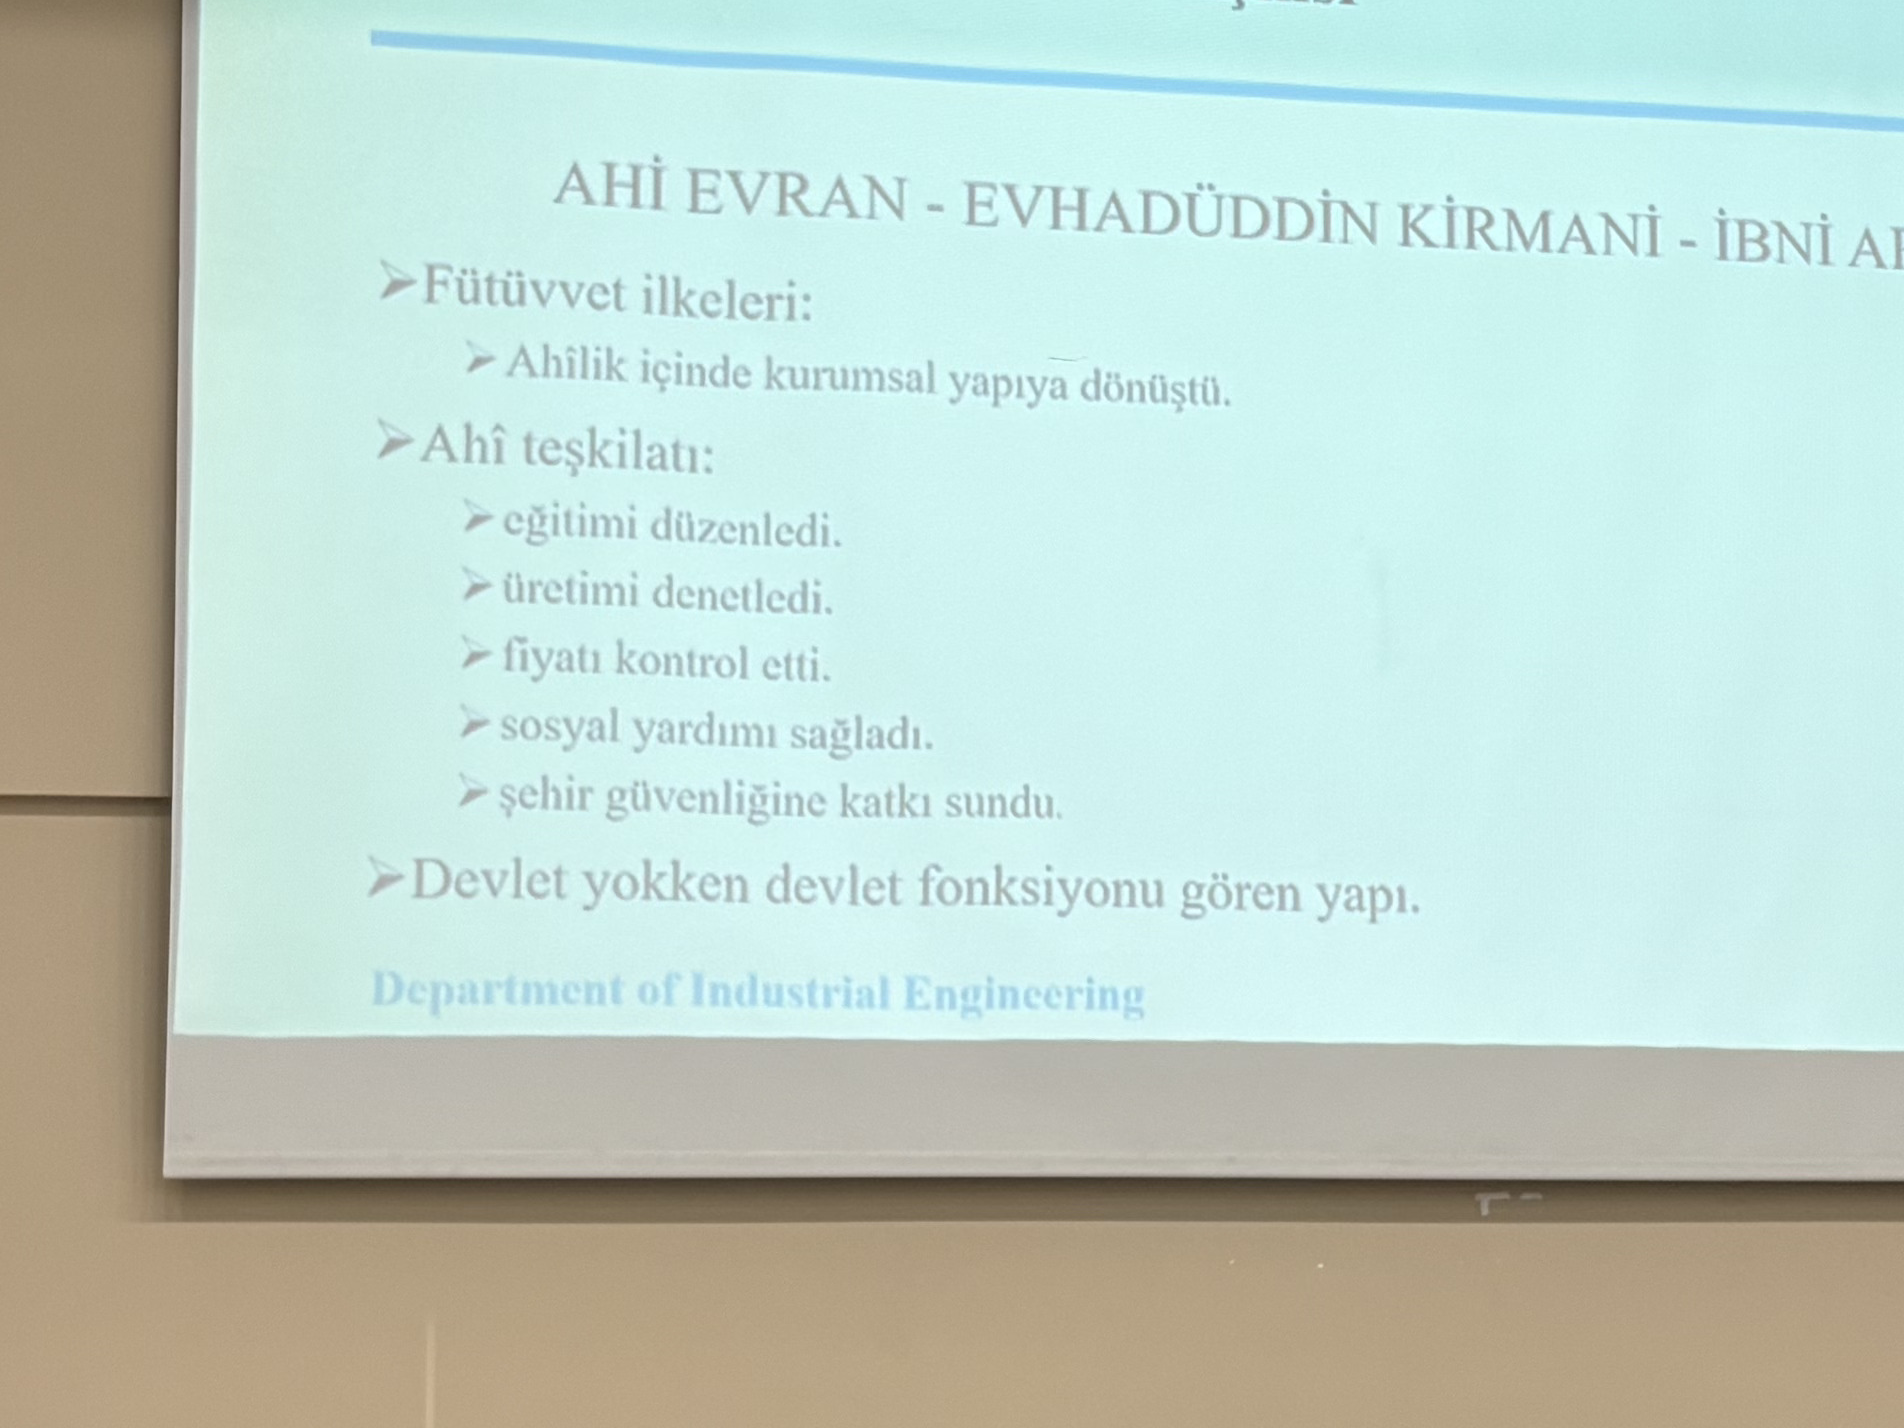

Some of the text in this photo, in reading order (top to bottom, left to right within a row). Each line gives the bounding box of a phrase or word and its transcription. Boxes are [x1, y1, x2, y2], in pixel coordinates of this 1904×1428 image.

[552, 153, 666, 211] AHİ
[686, 167, 908, 221] EVRAN
[963, 180, 1379, 245] EVHADÜDDİN
[1398, 194, 1661, 257] KİRMANİ
[1714, 207, 1833, 266] İBNİ
[423, 262, 811, 322] Fütüvvet ilkeleri:
[640, 347, 752, 394] içinde
[764, 355, 936, 394] kurumsal
[948, 369, 1068, 409] yapıya
[1080, 367, 1231, 413] dönüştü.
[420, 421, 713, 478] Ahî teşkilatı:
[503, 500, 842, 547] eğitimi düzenledi.
[503, 569, 833, 615] üretimi denetledi.
[504, 635, 831, 683] fiyatı kontrol etti.
[501, 706, 933, 761] sosyal yardımı sağladı.
[499, 774, 1062, 827] şehir güvenliğine katkı sundu.
[411, 856, 1420, 924] Devlet yokken devlet fonksiyonu gören yapı.
[373, 970, 1145, 1019] Department of Industrial Engineering
